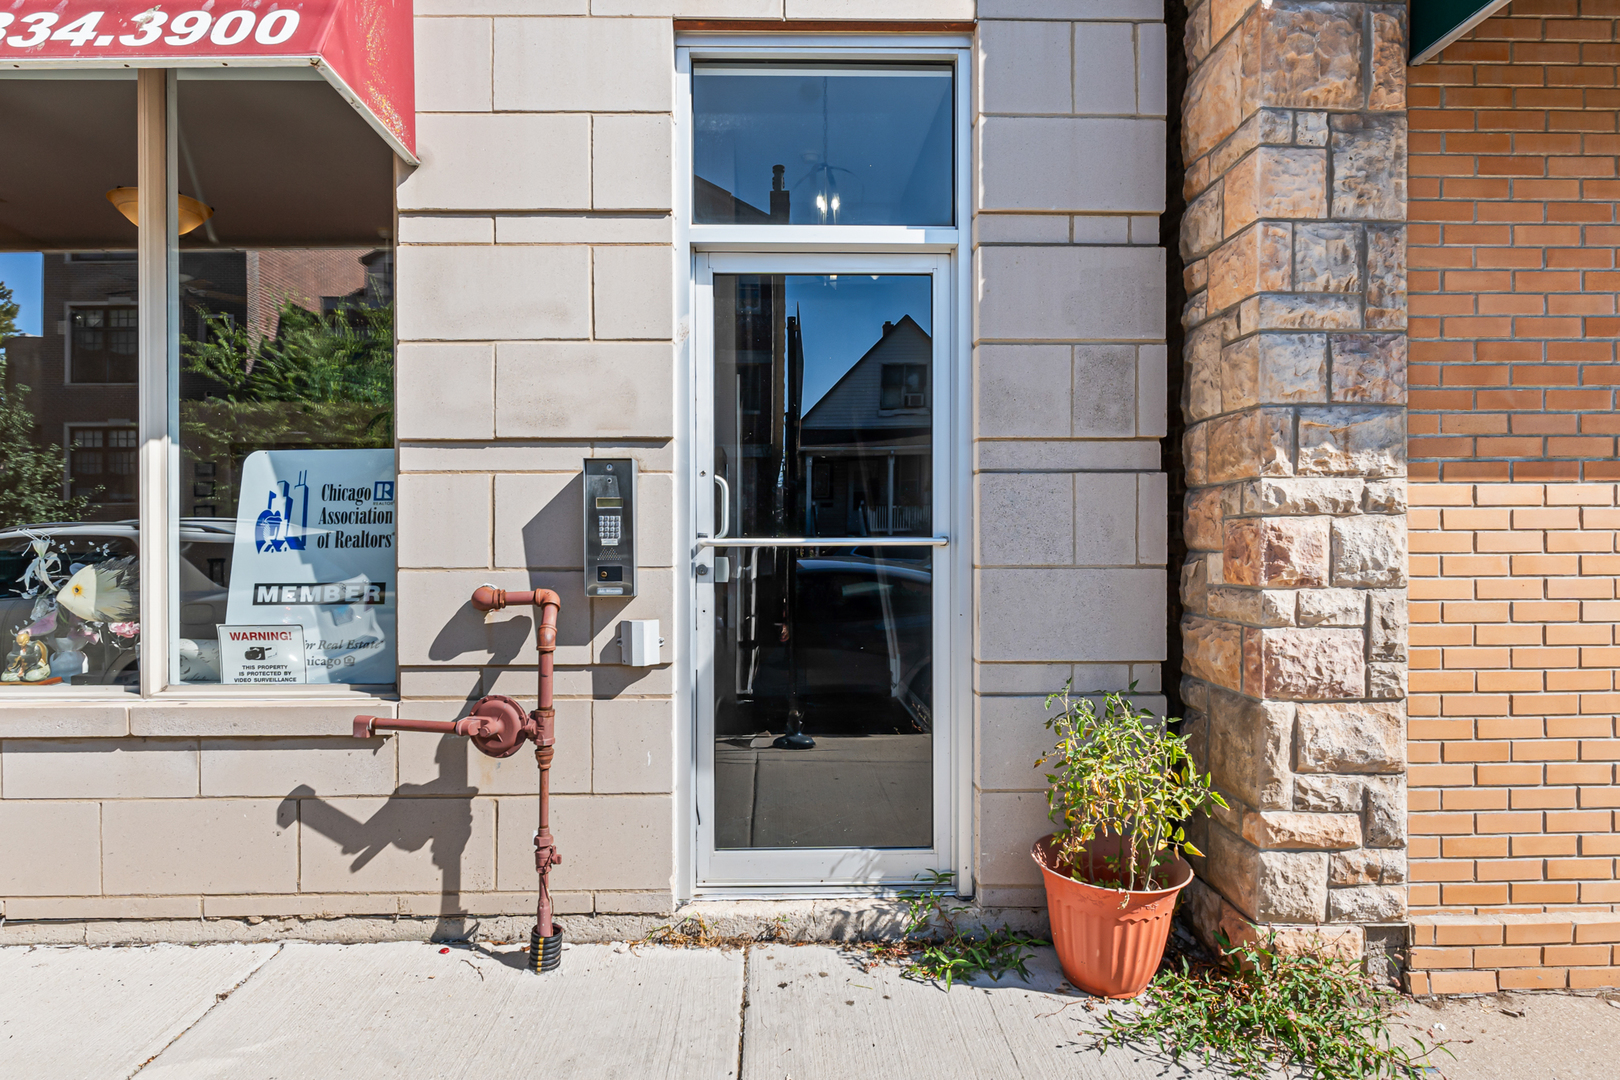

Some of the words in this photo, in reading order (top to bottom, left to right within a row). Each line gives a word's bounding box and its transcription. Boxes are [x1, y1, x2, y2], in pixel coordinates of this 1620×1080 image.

[0, 9, 300, 47] 34.3900
[322, 483, 372, 506] Chicago
[318, 507, 393, 525] Association
[317, 531, 332, 549] of
[257, 585, 381, 603] MEMBER
[229, 631, 292, 641] WARNING!
[317, 639, 344, 650] Real
